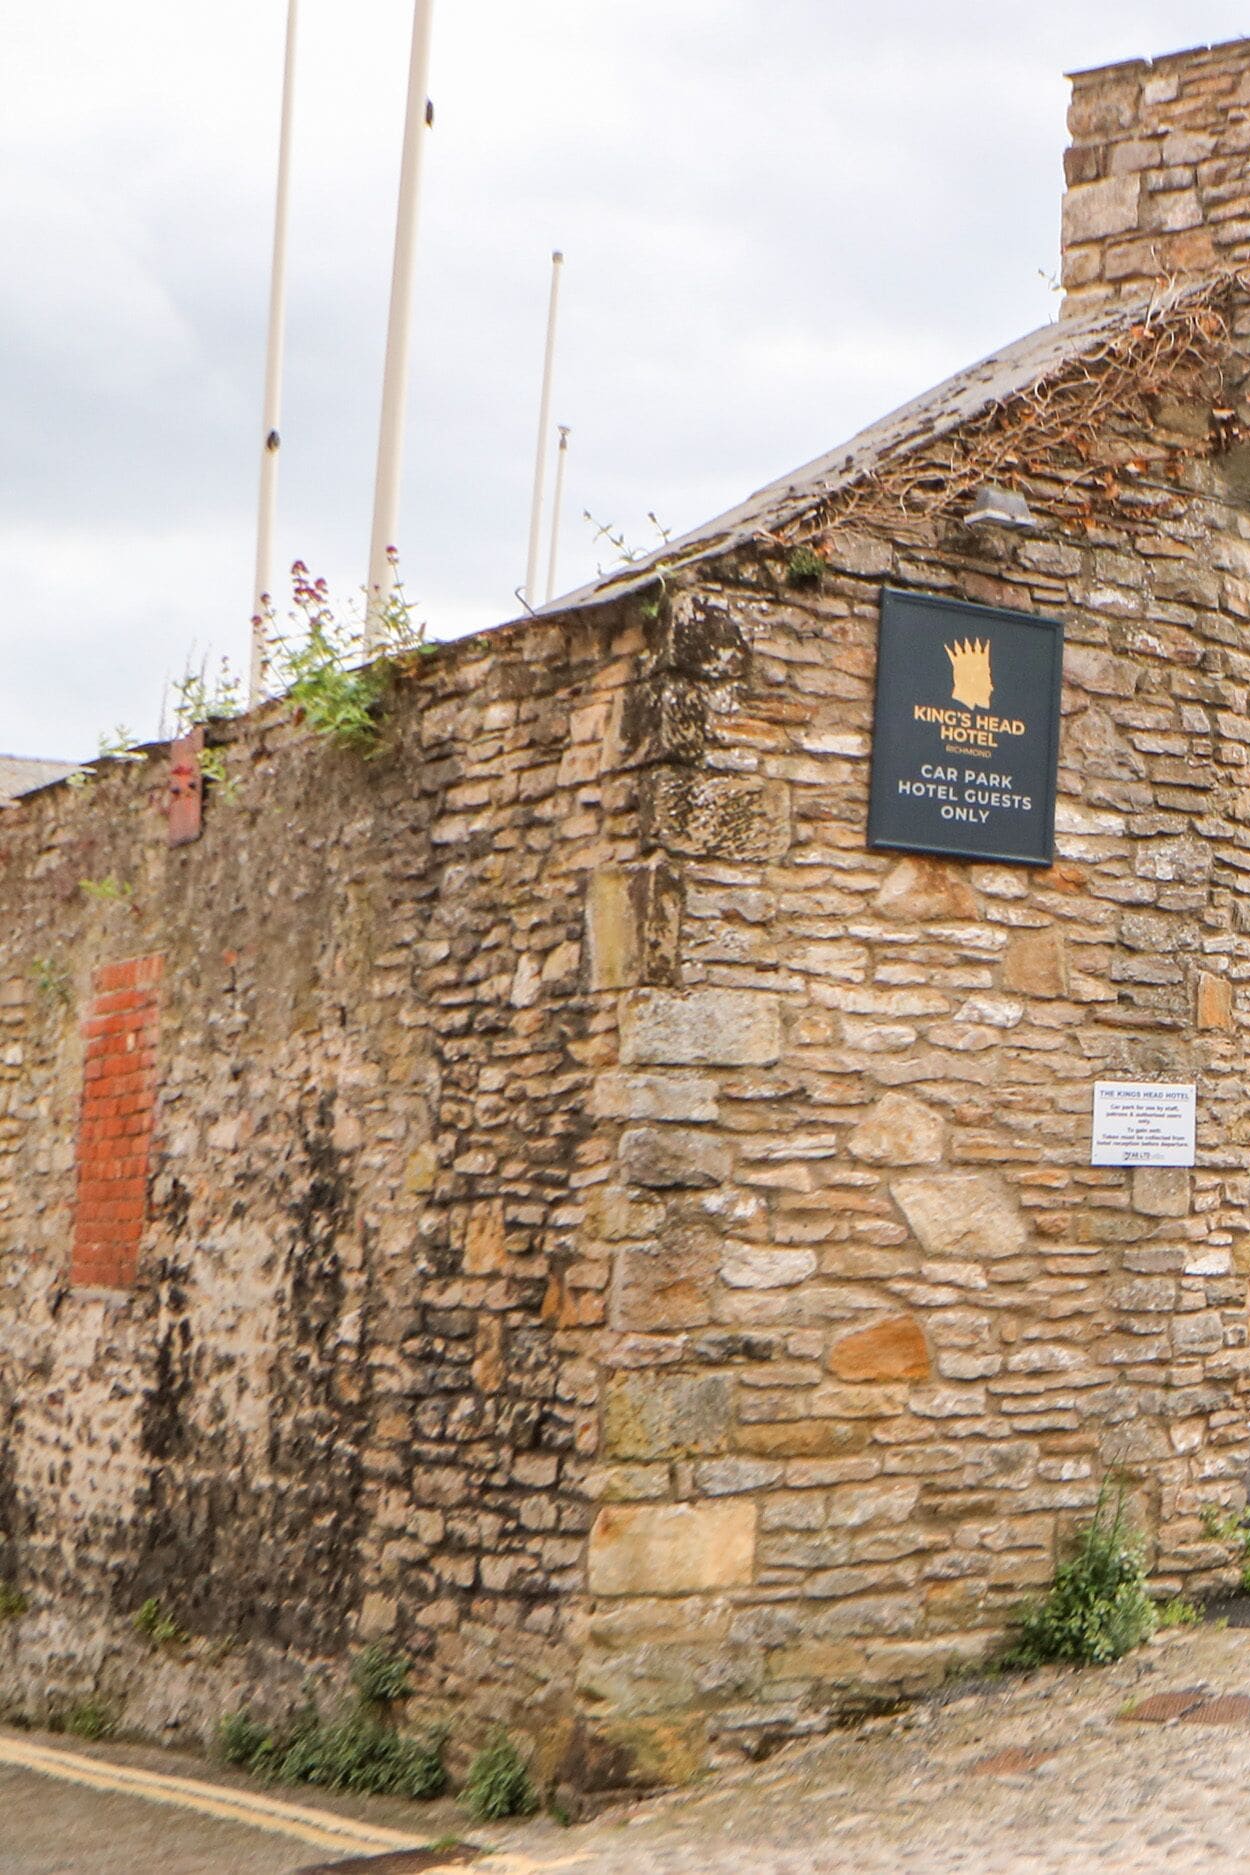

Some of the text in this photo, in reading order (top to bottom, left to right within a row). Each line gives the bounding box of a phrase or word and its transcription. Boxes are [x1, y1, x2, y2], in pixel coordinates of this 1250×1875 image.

[914, 705, 1025, 736] KING'S HEAD
[941, 725, 998, 748] HOTEL
[946, 744, 992, 758] RICHMOND
[921, 764, 1012, 789] CAR PARK
[898, 780, 1032, 810] HOTEL GUESTS
[941, 806, 990, 824] ONLY
[1117, 1090, 1141, 1098] KINGS
[1143, 1091, 1164, 1099] HEAD
[1165, 1092, 1189, 1100] HOTEL
